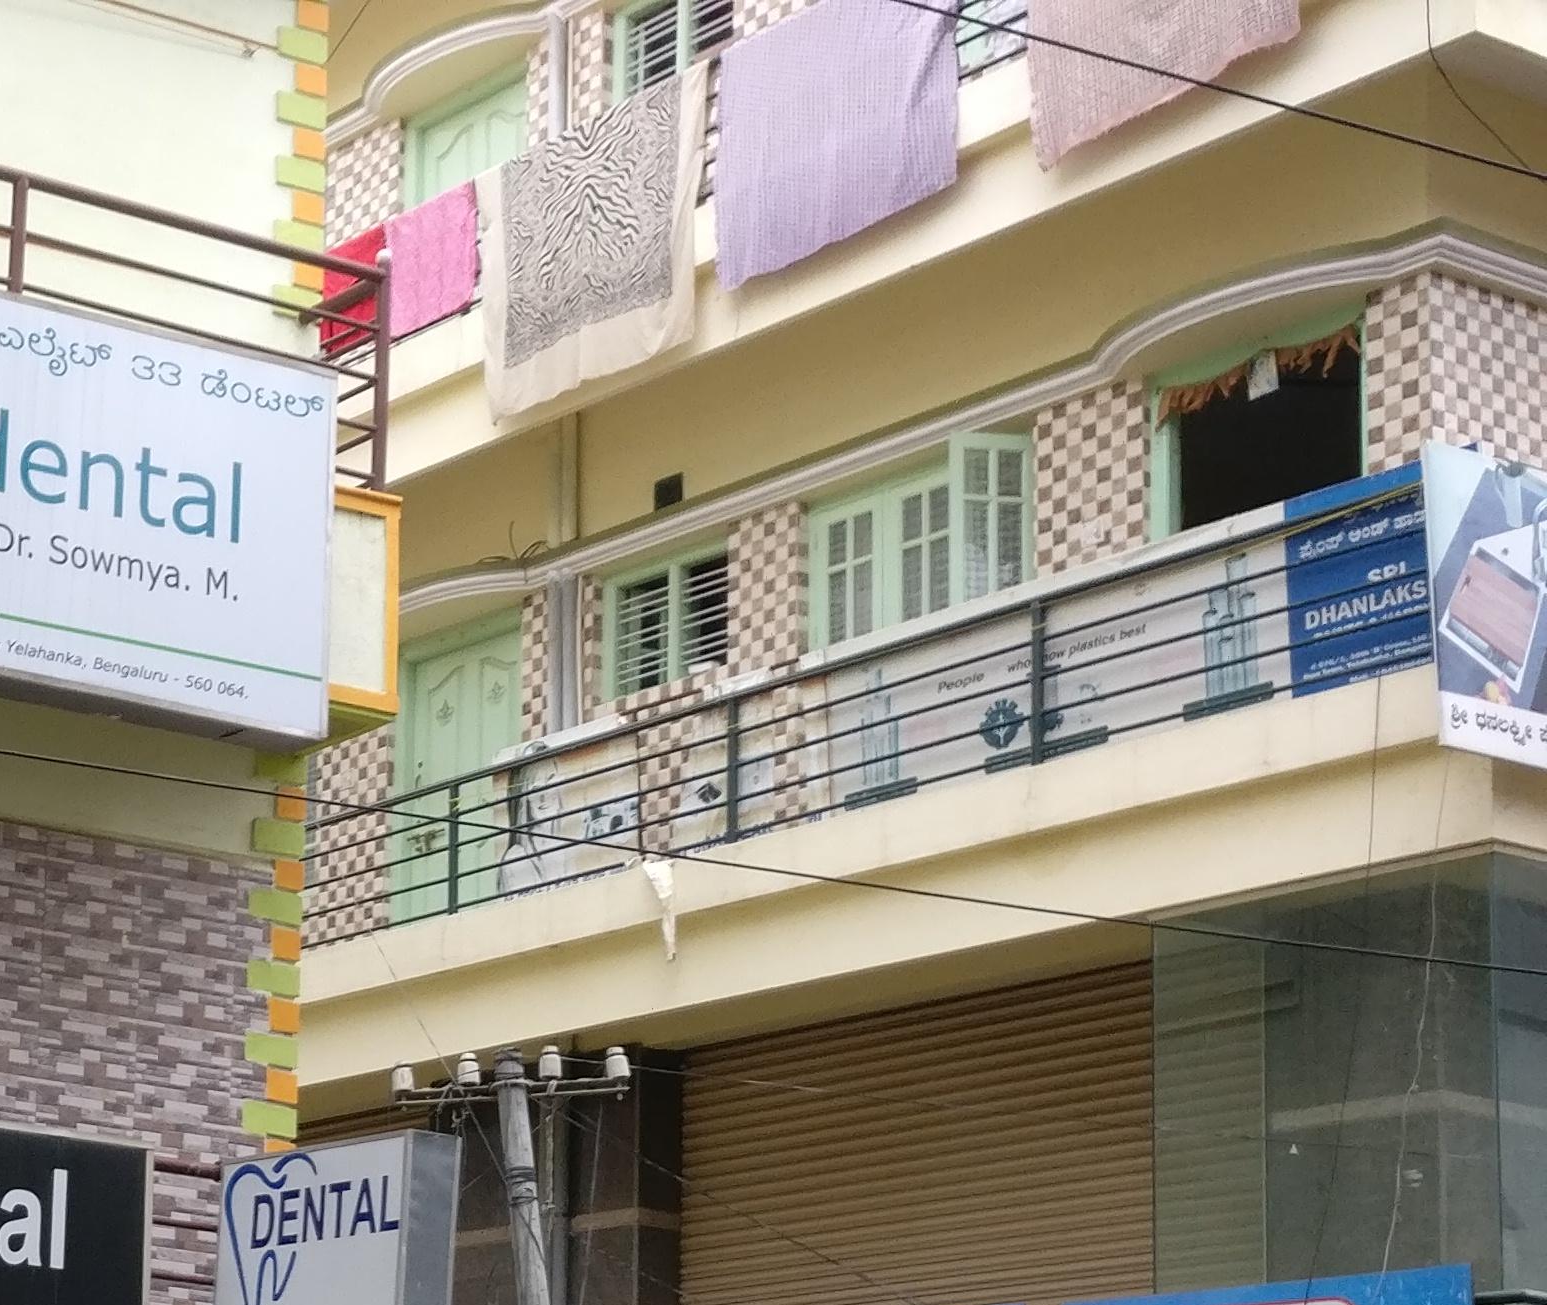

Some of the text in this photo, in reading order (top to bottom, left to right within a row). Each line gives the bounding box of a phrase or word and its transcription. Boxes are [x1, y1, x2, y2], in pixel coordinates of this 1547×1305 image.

[48, 536, 191, 592] Sowmya.
[205, 568, 240, 602] M.
[7, 639, 88, 670] Yelahanka,
[93, 656, 170, 684] Bengaluru
[184, 675, 213, 693] 560
[937, 671, 985, 694] People
[1069, 634, 1116, 661] plastics
[1119, 623, 1147, 641] best
[250, 1174, 400, 1250] DENTAL
